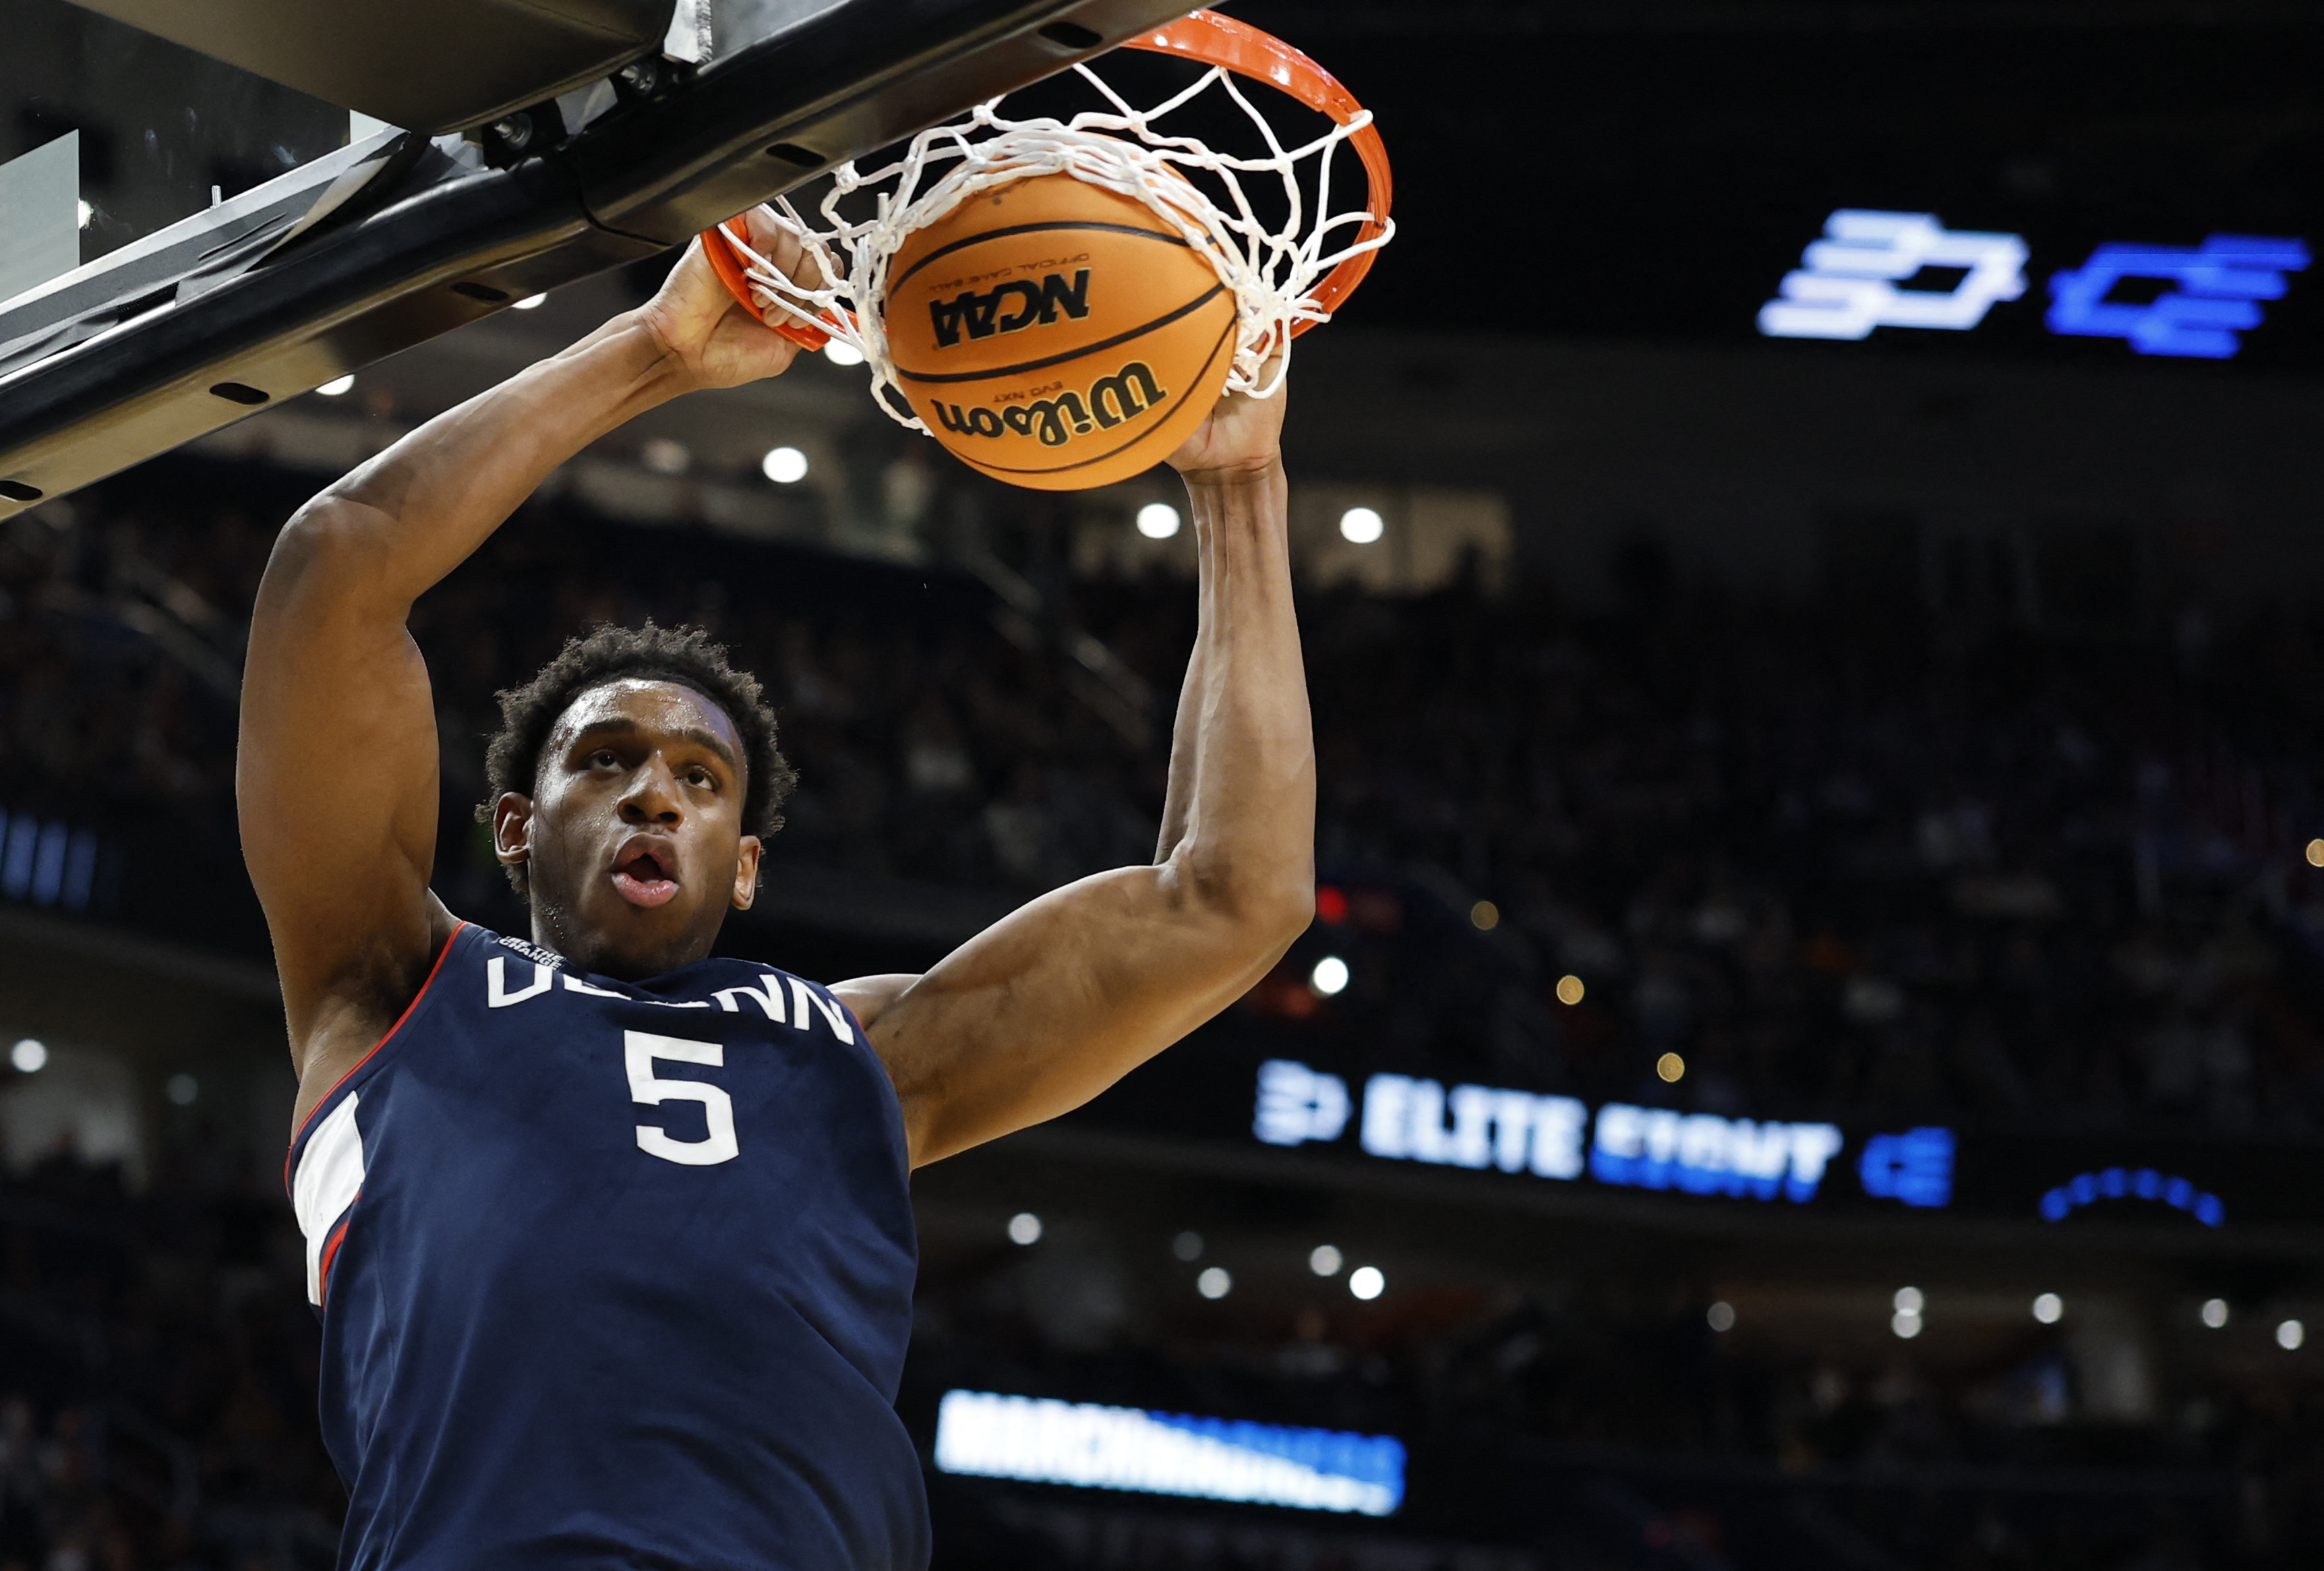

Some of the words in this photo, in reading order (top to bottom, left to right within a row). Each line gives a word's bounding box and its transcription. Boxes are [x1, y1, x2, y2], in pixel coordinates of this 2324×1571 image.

[1017, 253, 1090, 271] OFFICIAL
[928, 279, 964, 293] BALL
[928, 268, 1092, 347] NCAA
[930, 360, 1168, 448] Wilson
[993, 391, 1025, 403] NXT
[1029, 380, 1063, 396] EVO
[499, 938, 562, 970] CHANGE
[533, 947, 564, 962] THE
[487, 956, 854, 1045] UNN
[624, 1029, 739, 1166] 5
[1362, 1073, 1586, 1179] ELITE
